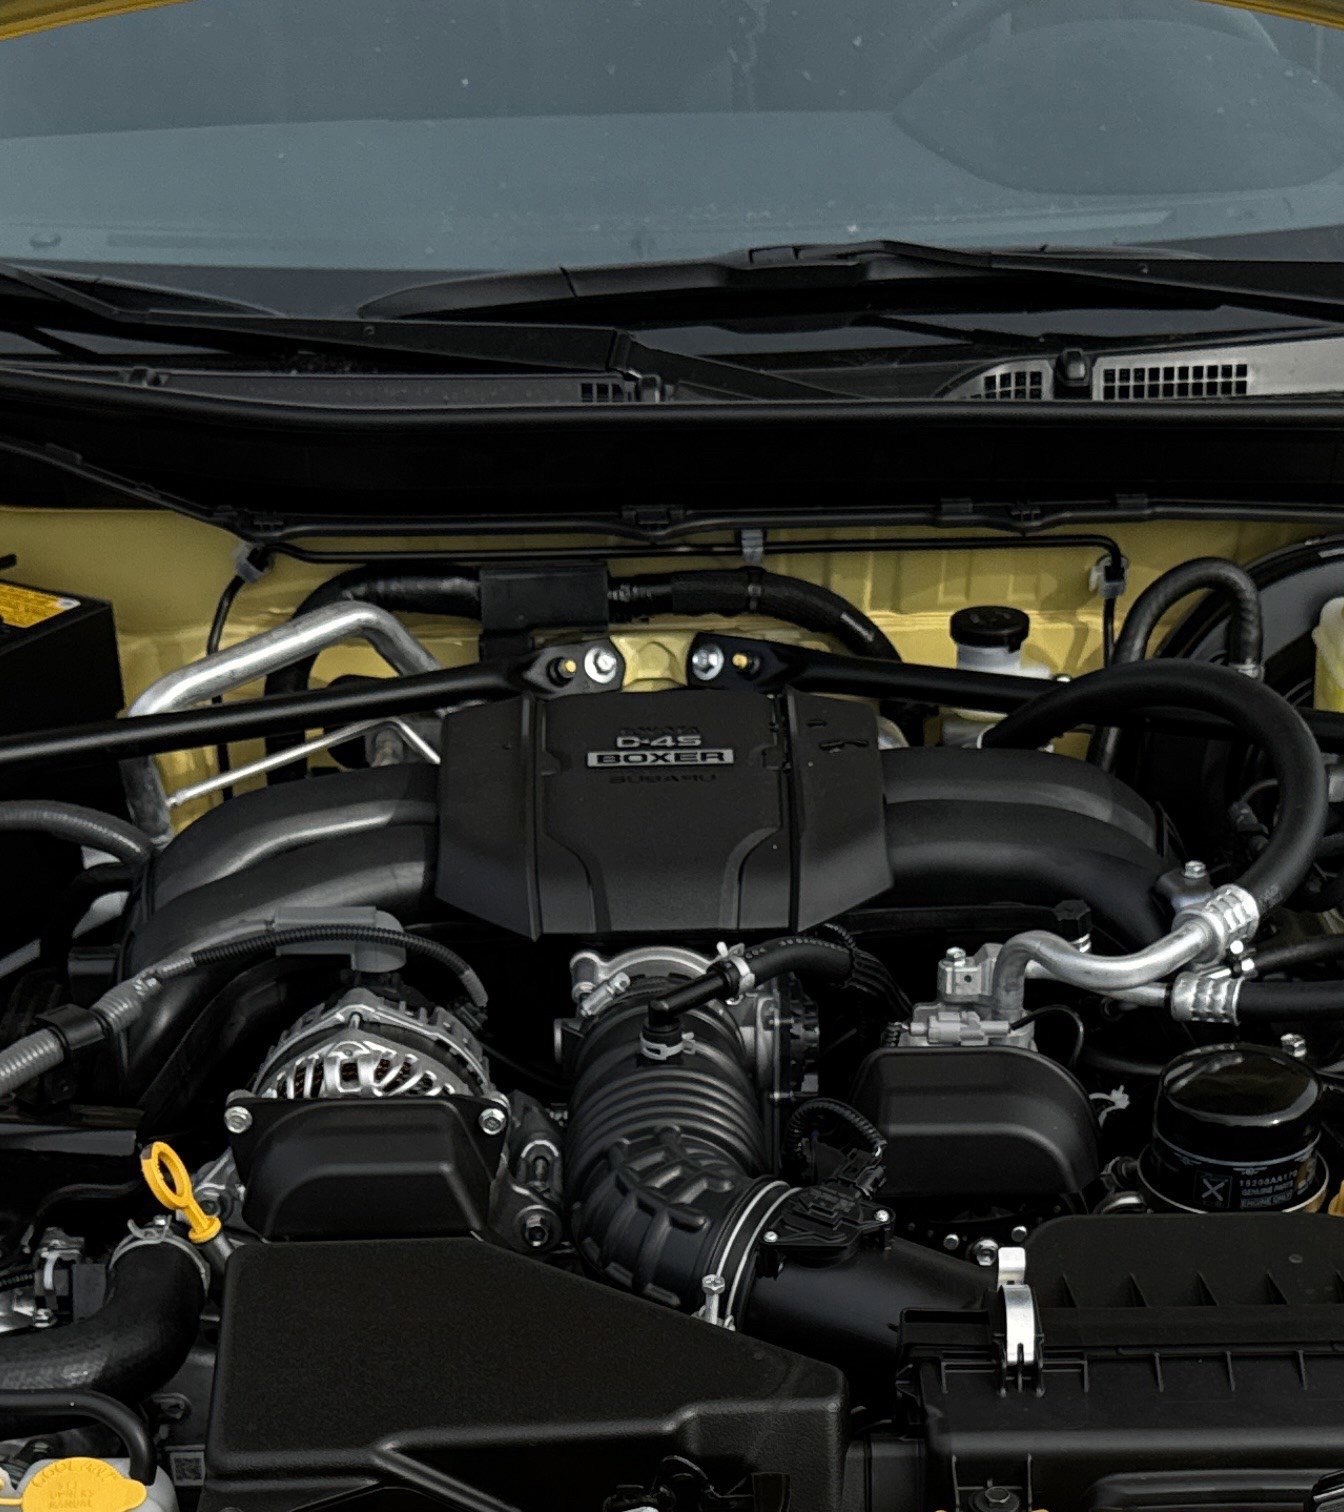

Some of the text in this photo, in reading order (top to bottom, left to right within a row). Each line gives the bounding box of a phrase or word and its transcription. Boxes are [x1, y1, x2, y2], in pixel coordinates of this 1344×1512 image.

[616, 735, 702, 748] D-4S
[596, 751, 726, 764] BOXER
[608, 773, 717, 784] SUBARU
